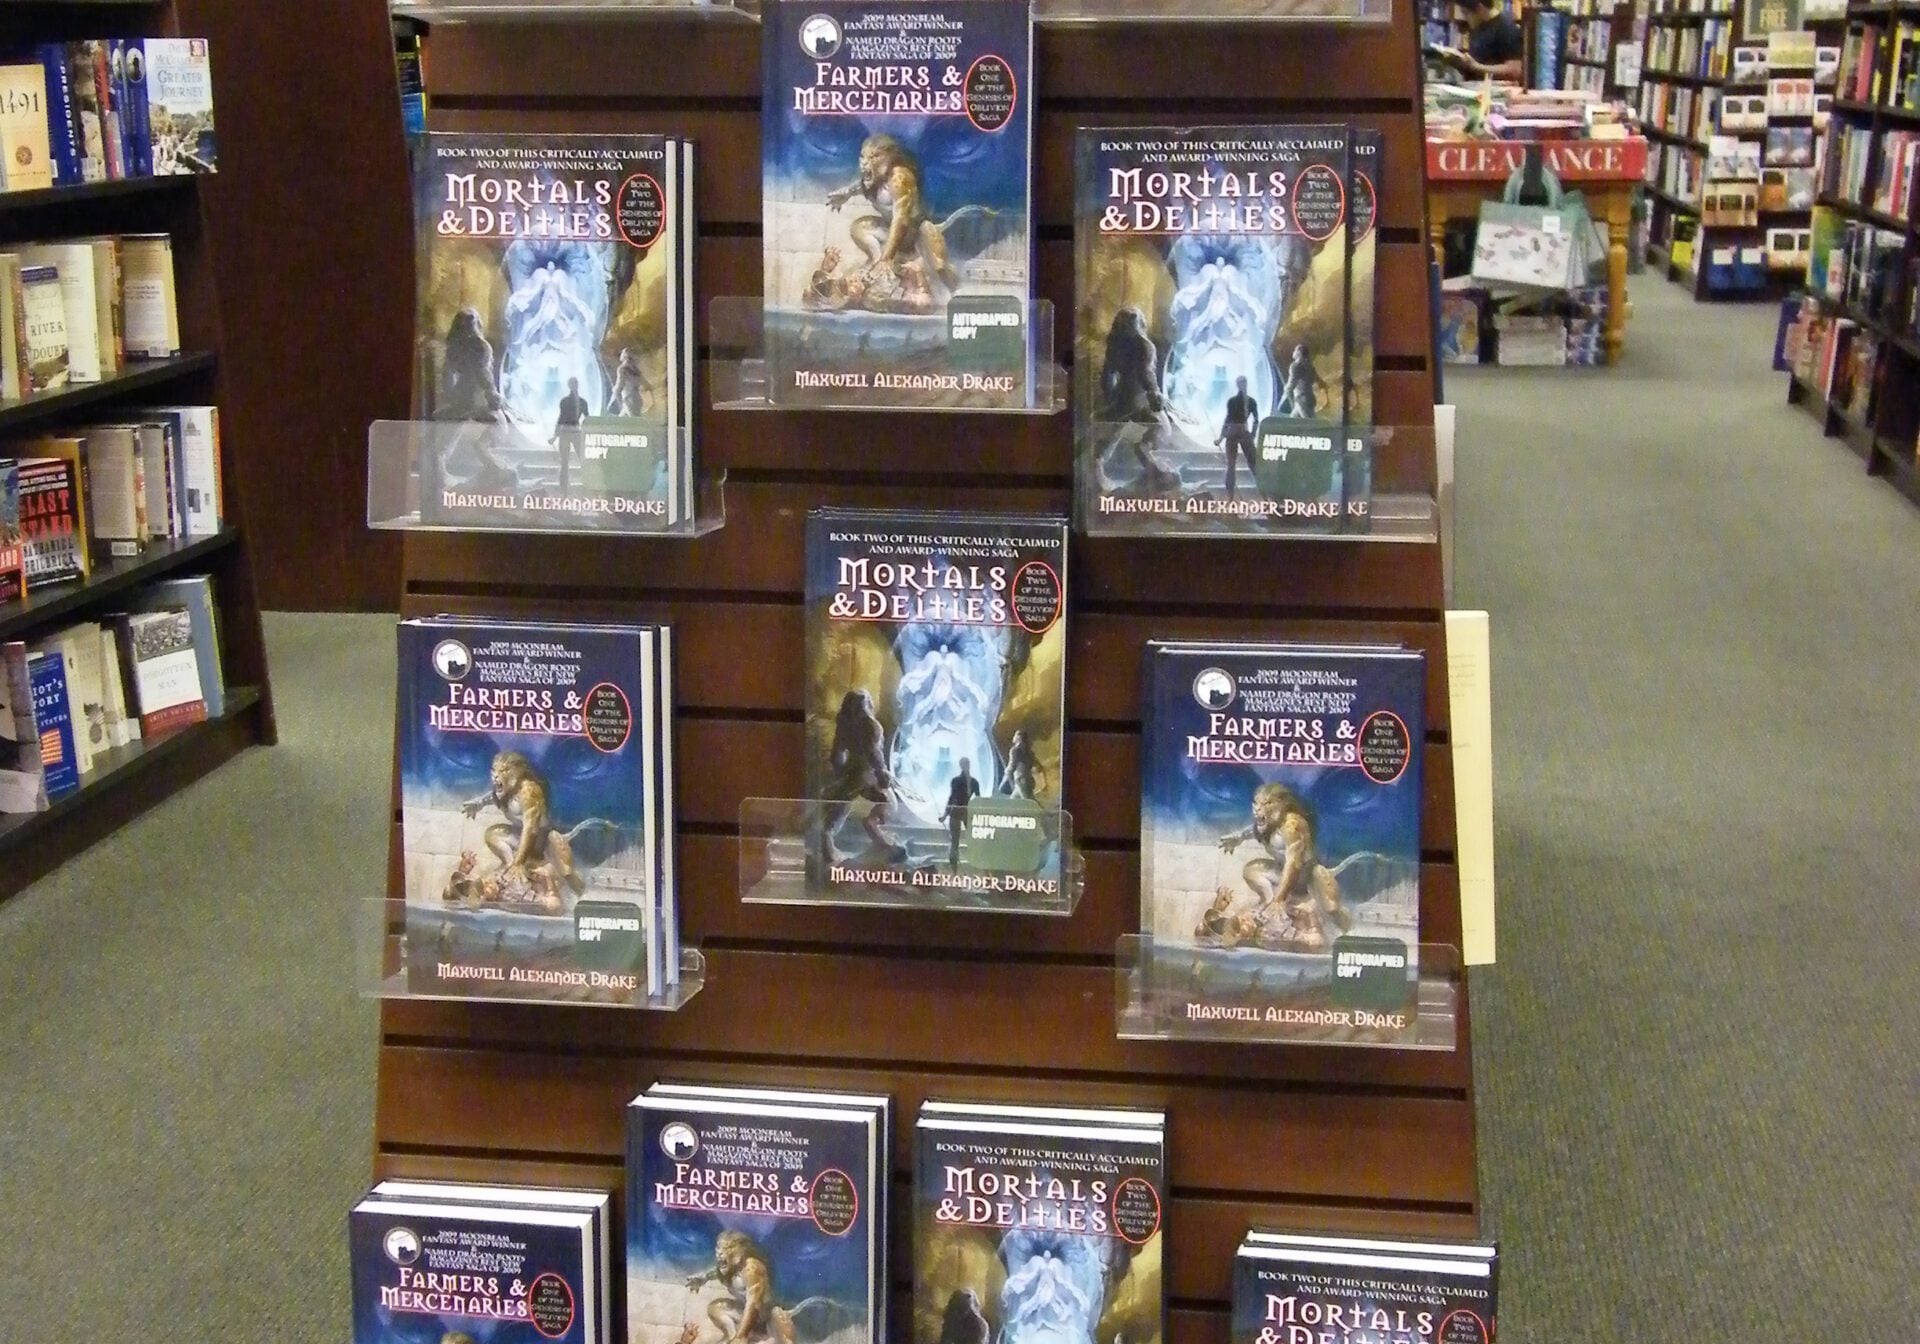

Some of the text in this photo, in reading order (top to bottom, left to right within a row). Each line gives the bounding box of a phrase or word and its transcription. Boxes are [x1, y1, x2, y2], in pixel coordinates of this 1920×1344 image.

[886, 14, 945, 22] MOONBEAM
[846, 36, 961, 44] NAMED DRAGON ROOTS
[910, 44, 931, 52] BEST
[934, 44, 956, 52] NEW
[851, 51, 956, 59] FANTASY SAGA OF 2009
[158, 70, 203, 83] GREATER
[816, 63, 963, 89] FARMERS &
[0, 89, 39, 118] 1491
[160, 85, 204, 101] JOURNEY
[793, 87, 962, 113] MERCENARIES
[60, 65, 76, 157] PRESIDENTS
[437, 148, 664, 160] BOOK TWO OF THIS CRITICALLY ACCLAIMED
[1101, 142, 1133, 151] BOOK
[1134, 142, 1161, 150] TWO
[1163, 141, 1179, 150] OF
[1183, 141, 1210, 150] THIS
[1211, 141, 1275, 150] CRITICALLY
[1276, 140, 1344, 150] ACCLAIMED
[476, 161, 623, 171] AND AWARD-WINNING SAGA
[1142, 153, 1300, 162] AND AWARD-WINNING SAGA
[1438, 147, 1622, 172] CLEAANCE
[446, 173, 612, 208] MORTALS
[1109, 168, 1287, 204] MORTALS
[469, 206, 612, 237] DEITIES
[1133, 201, 1287, 231] DEITIES
[30, 321, 64, 337] RIVER
[952, 313, 1020, 326] AUTOGRAPHED
[952, 327, 977, 339] COPY
[795, 371, 1014, 392] MAXWELL ALEXANDER DRAKE
[585, 434, 648, 448] AUTOGRAPHED
[1263, 434, 1331, 450] AUTOGRAPHED
[585, 447, 608, 459] COPY
[1263, 448, 1288, 461] COPY
[27, 489, 70, 515] LAST
[443, 491, 665, 515] MAXWELL ALEXANDER DRAKE
[1100, 496, 1179, 514] MAXWELL
[1185, 498, 1282, 517] ALEXANDER
[1283, 498, 1339, 517] DRAKE
[829, 532, 1061, 548] BOOK TWO OF THIS CRITICALLY ACCLAIMED
[869, 545, 1020, 558] AND AWARD-WINNING SAGA
[838, 557, 1006, 592] MORTALS
[861, 589, 1006, 622] DEITIES
[449, 684, 583, 711] FARMERS &
[429, 705, 583, 733] MERCENARIES
[1210, 714, 1357, 741] FARMERS &
[1187, 735, 1356, 763] MERCENARIES
[971, 814, 1036, 830] AUTOGRAPHED
[971, 827, 995, 839] COPY
[830, 866, 1057, 893] MAXWELL ALEXANDER DRAKE
[579, 917, 640, 931] AUTOGRAPHED
[579, 929, 602, 942] COPY
[1337, 952, 1405, 968] AUTOGRAPHED
[437, 962, 637, 990] MAXWELL ALEXANDER DRAKE
[1337, 965, 1362, 978] COPY
[1187, 1003, 1406, 1030] MAXWELL ALEXANDER DRAKE
[936, 1143, 1159, 1166] BOOK TWO OF THIS CRITICALLY ACCLAIMED
[974, 1156, 1120, 1174] AND AWARD-WINNING SAGA
[675, 1163, 809, 1194] FARMERS &
[944, 1166, 1107, 1203] MORTALS
[655, 1182, 809, 1215] MERCENARIES
[967, 1196, 1107, 1232] DEITIES
[399, 1268, 528, 1297] FARMERS &
[1258, 1271, 1488, 1298] BOOK TWO OF THIS CRITICALLY ACCLAIMED
[380, 1286, 528, 1317] MERCENARIES
[1297, 1284, 1447, 1305] AND AWARD-WINNING SAGA
[1265, 1295, 1433, 1334] MORTALS
